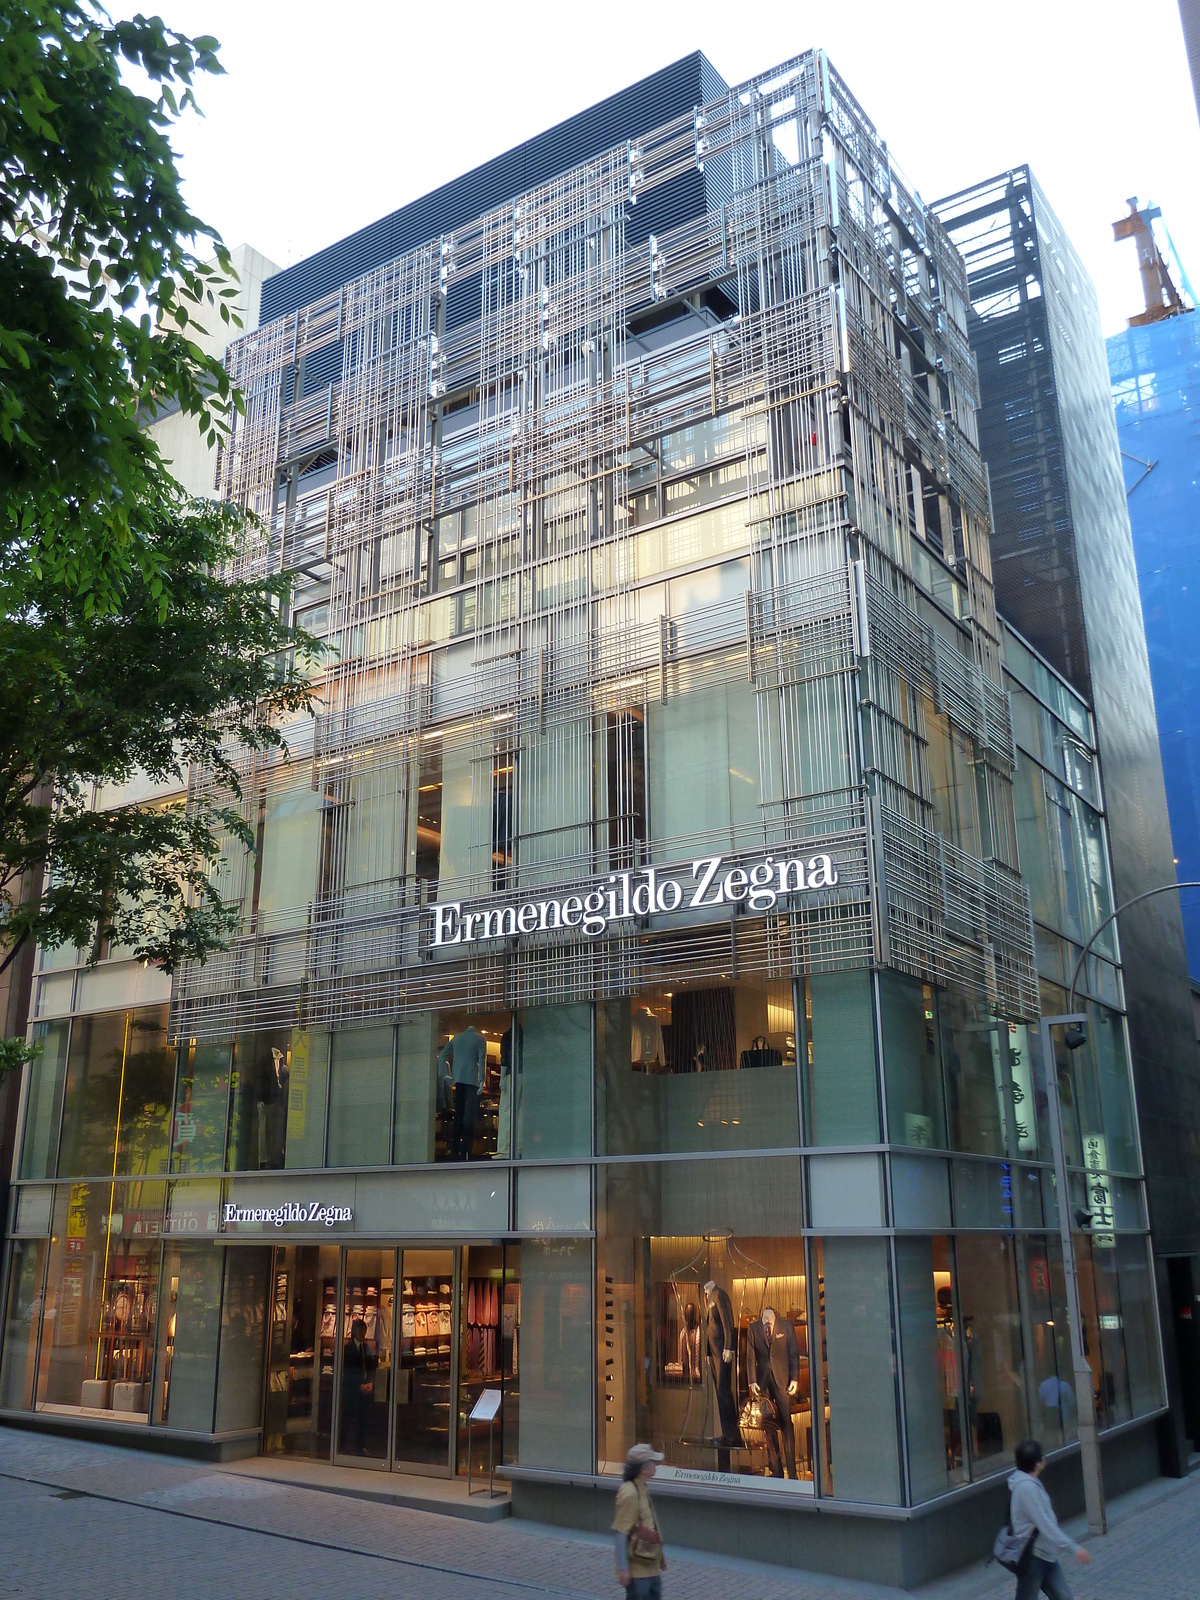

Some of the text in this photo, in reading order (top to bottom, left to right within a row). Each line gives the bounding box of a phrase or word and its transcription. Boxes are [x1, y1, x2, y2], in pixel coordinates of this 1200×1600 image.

[429, 853, 839, 948] Ermenegildo Zegna
[223, 1202, 308, 1227] Ermenegildo
[307, 1202, 353, 1227] Zegna
[674, 1469, 741, 1484] Ermenegildo Zegna
